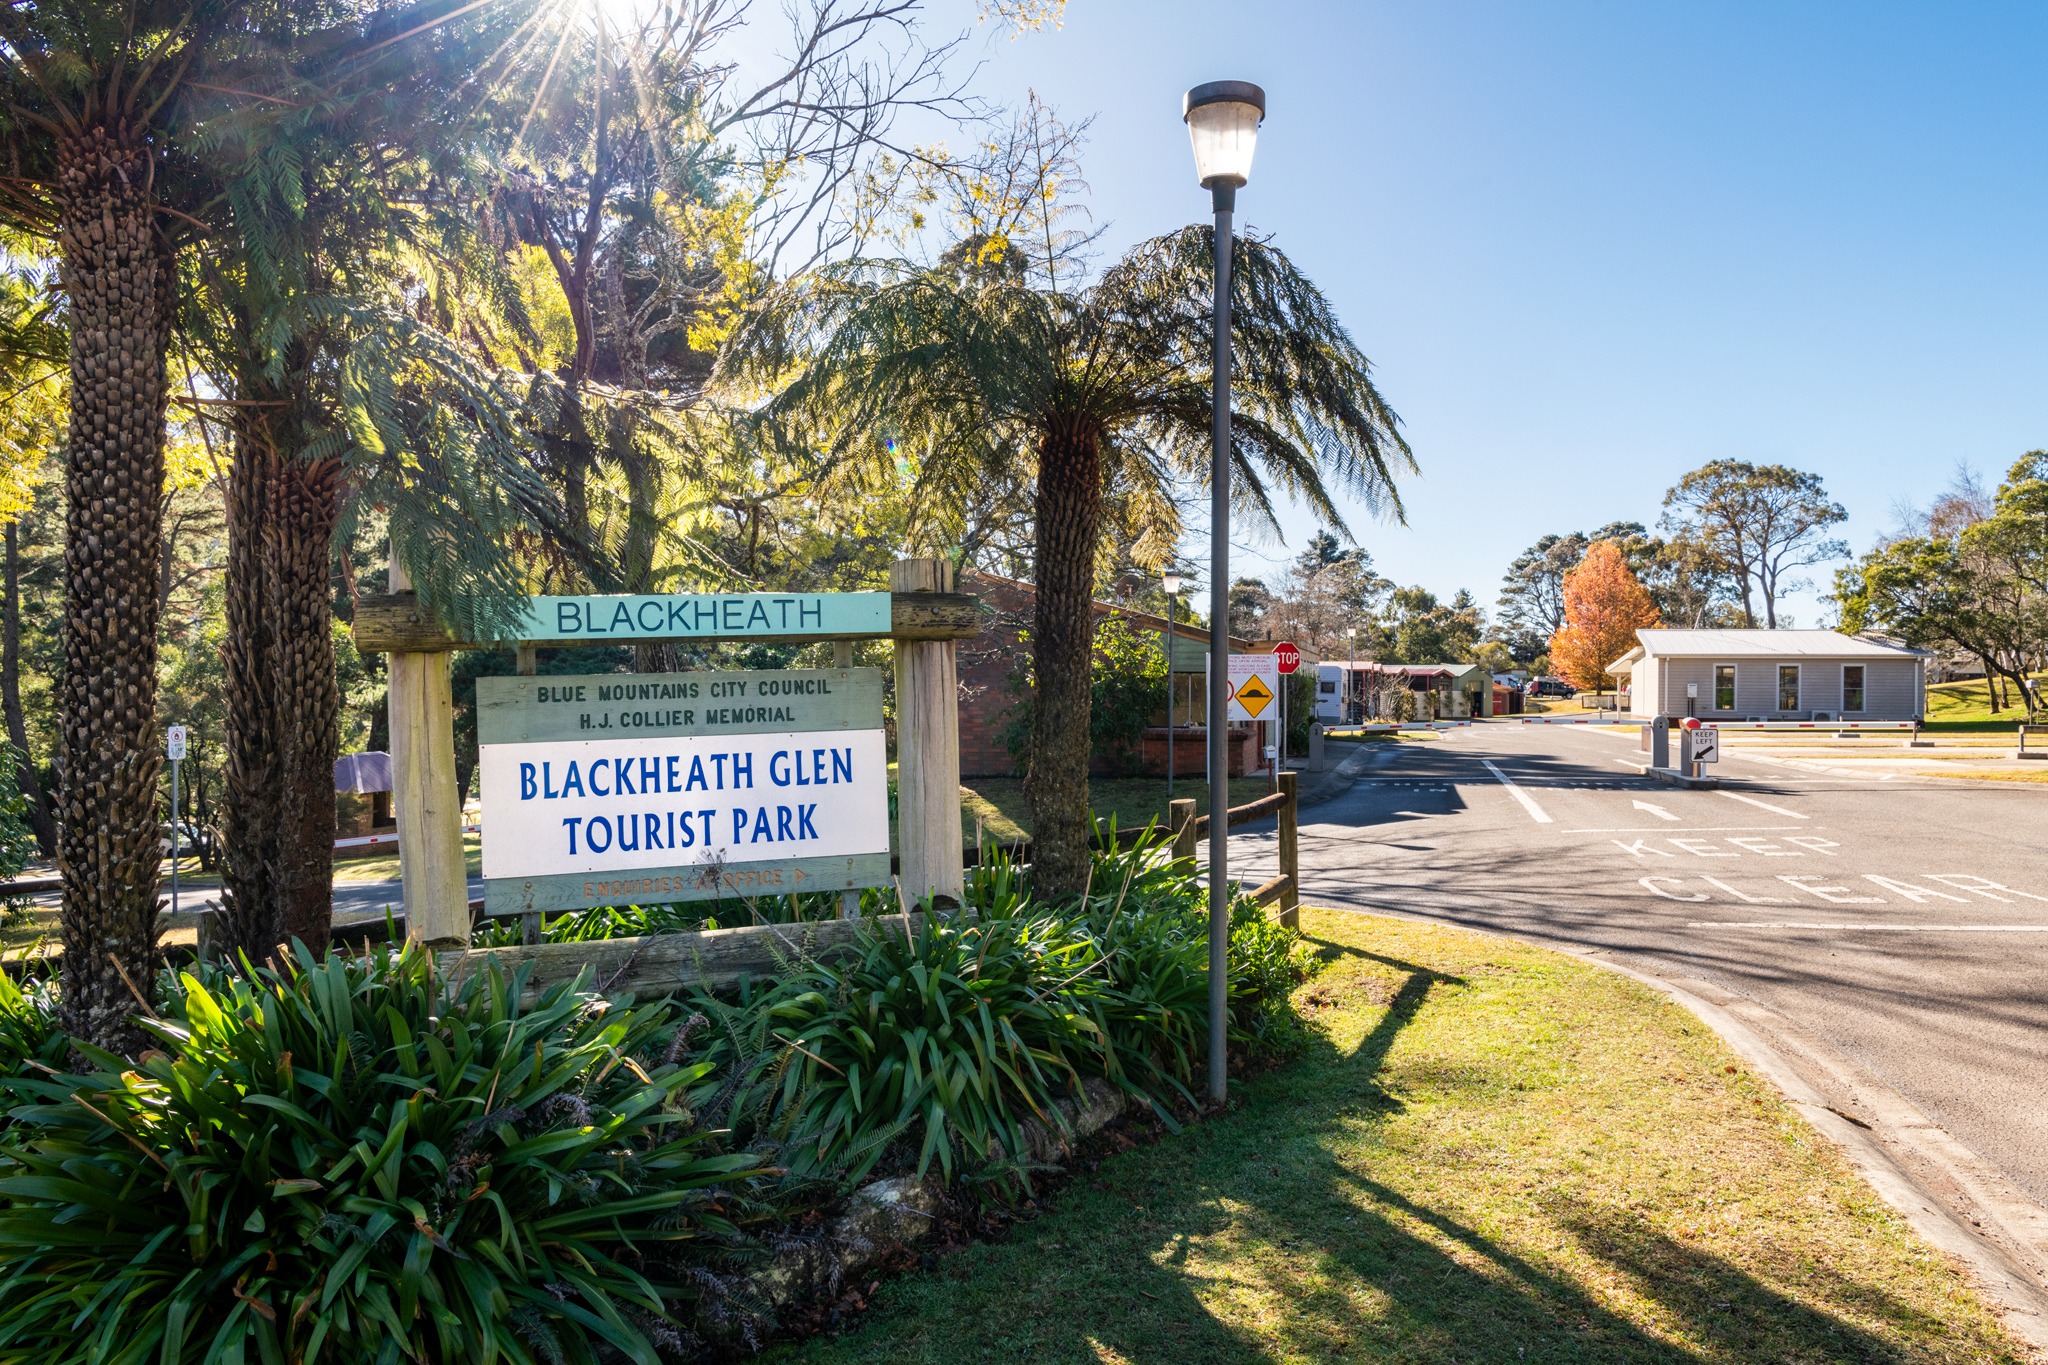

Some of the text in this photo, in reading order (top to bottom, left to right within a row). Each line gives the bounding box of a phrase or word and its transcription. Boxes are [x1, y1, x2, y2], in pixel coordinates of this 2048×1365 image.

[557, 599, 822, 634] BLACKHEATH
[537, 679, 832, 703] BLUE MOUNTAINS CITY COUNCIL
[580, 706, 796, 729] H.J. COLLIER MEMORIAL
[520, 747, 853, 800] BLACKHEATH GLEN
[562, 803, 819, 855] TOURIST PARK
[1610, 836, 1841, 857] KEEP
[584, 876, 683, 898] ENQUIRIES
[724, 869, 783, 888] OFFICE
[1638, 874, 2048, 903] CLEAR
